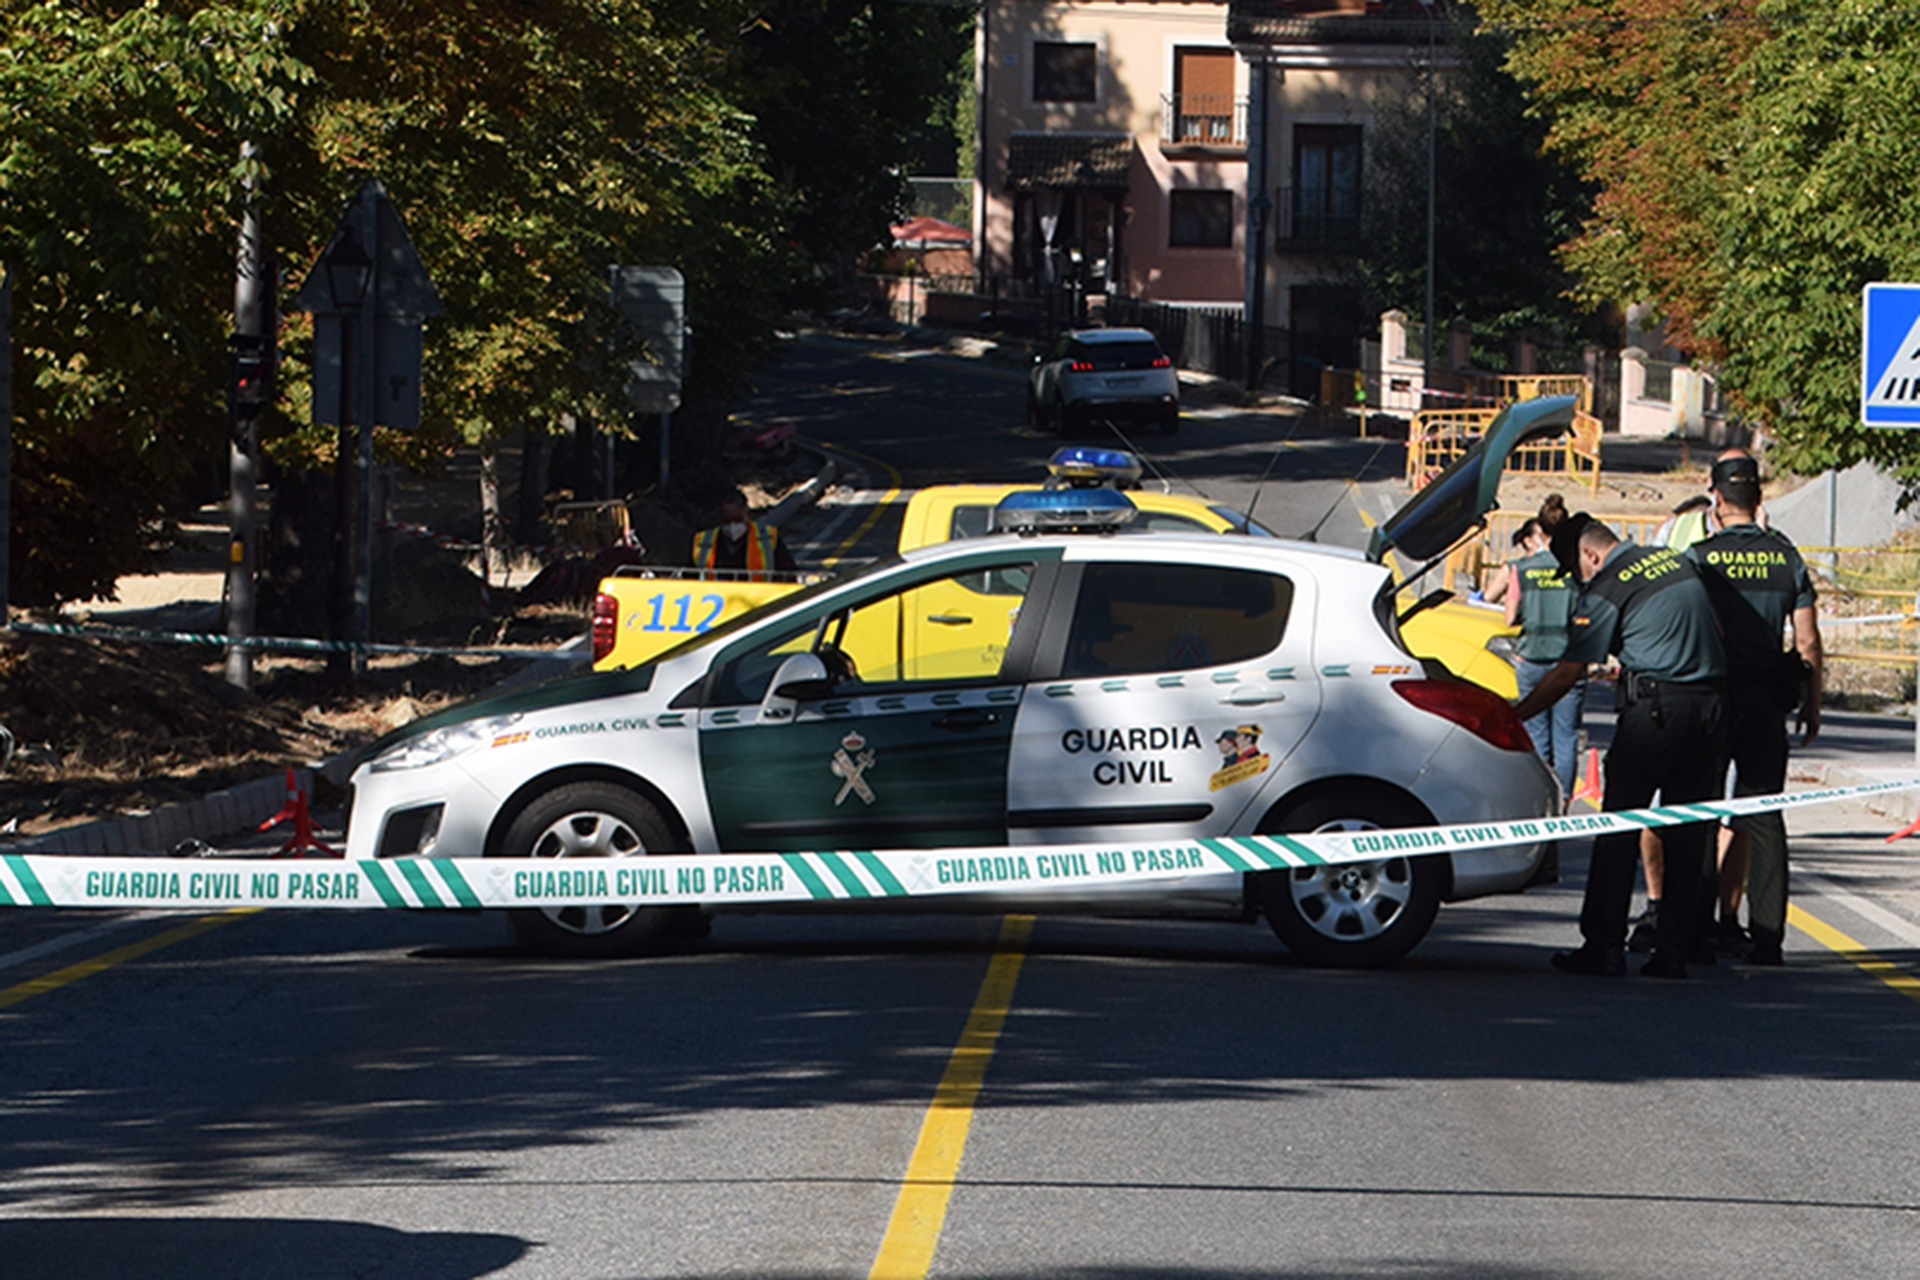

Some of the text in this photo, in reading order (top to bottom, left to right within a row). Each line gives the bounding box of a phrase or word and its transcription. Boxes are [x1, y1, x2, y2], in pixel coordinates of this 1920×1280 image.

[1643, 559, 1681, 580] CIVIL
[1706, 551, 1787, 565] GUARDIA
[1726, 565, 1768, 579] CIVIL
[642, 593, 725, 634] 112
[535, 718, 651, 738] GUARDIA CIVIL
[1062, 725, 1202, 754] GUARDIA
[1093, 760, 1173, 785] CIVIL
[1352, 815, 1615, 853] GUARDIA CIVIL NO PASAR
[936, 847, 1204, 884] GUARDIA CIVIL NO PASAR
[86, 871, 359, 899] GUARDIA CIVIL NO PASAR
[514, 865, 784, 898] GUARDIA CIVIL NO PASAR
